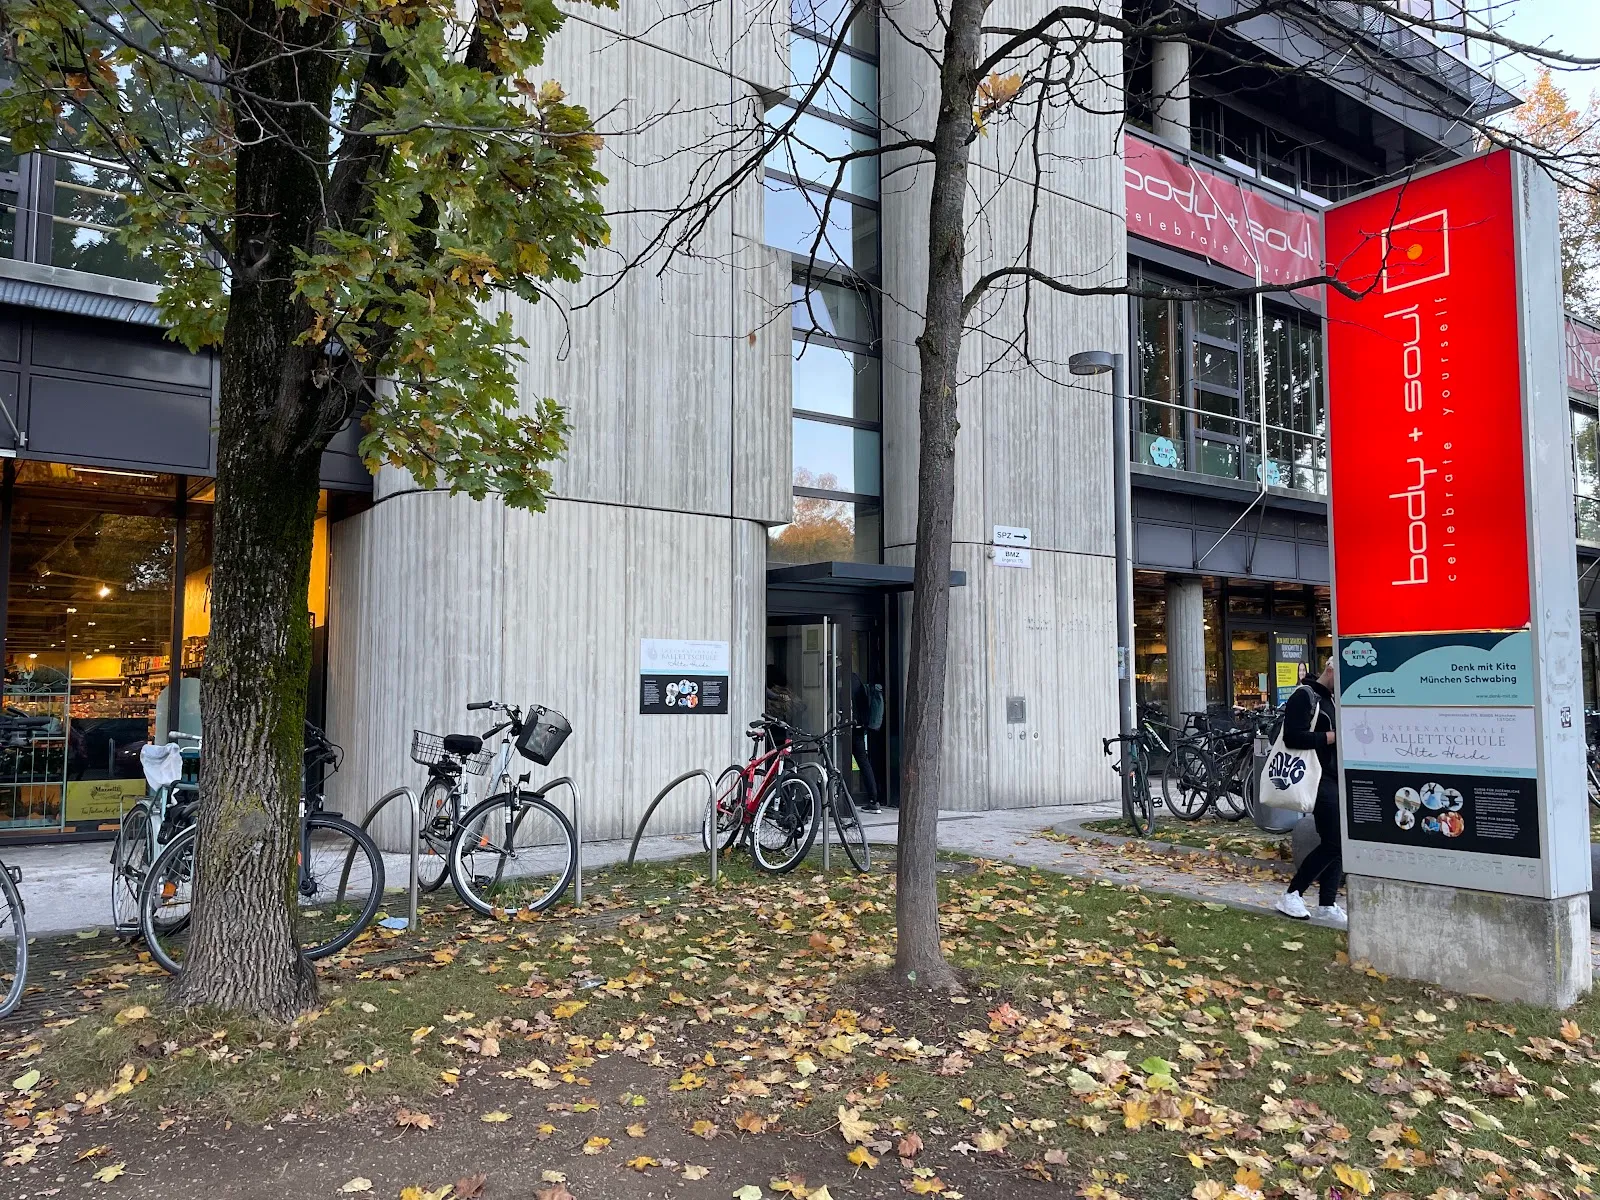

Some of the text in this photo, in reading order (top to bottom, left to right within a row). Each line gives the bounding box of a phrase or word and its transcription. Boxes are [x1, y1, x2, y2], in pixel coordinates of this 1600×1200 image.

[1246, 219, 1314, 261] soul
[1383, 303, 1423, 412] soul
[1434, 296, 1457, 582] celebrate yourself
[1389, 456, 1437, 586] body
[997, 531, 1012, 539] SPZ
[1451, 662, 1516, 672] Denk mit Kita
[1420, 674, 1517, 685] München Schwabing
[1368, 686, 1395, 695] 1.Stock
[1381, 724, 1505, 734] INTERNATIONALE
[1381, 732, 1506, 747] BALLETTSCHULE
[1394, 743, 1491, 760] Alte Heide
